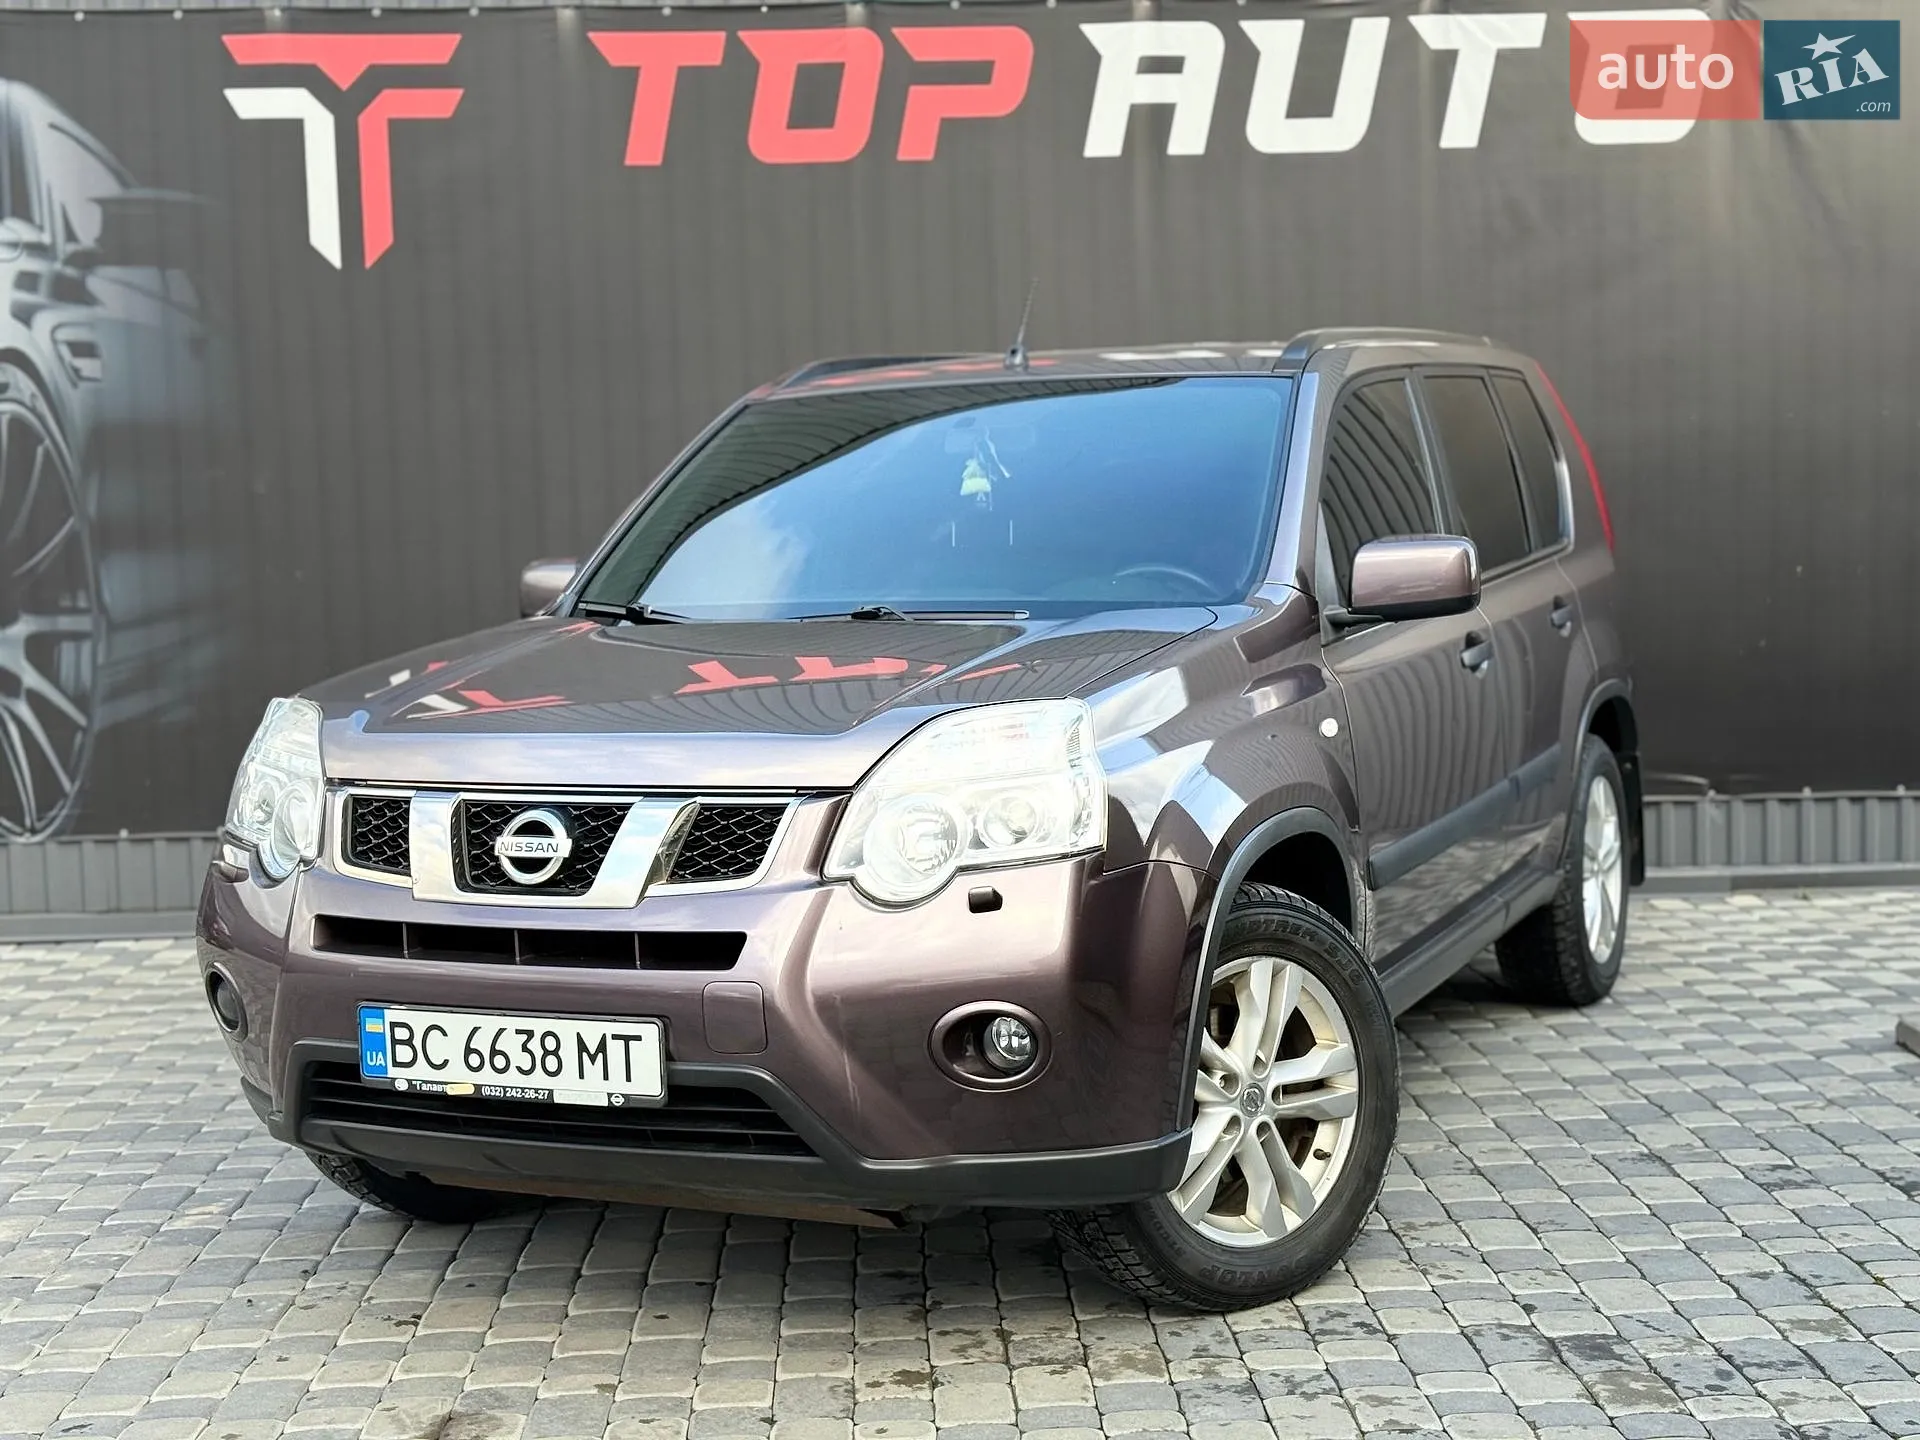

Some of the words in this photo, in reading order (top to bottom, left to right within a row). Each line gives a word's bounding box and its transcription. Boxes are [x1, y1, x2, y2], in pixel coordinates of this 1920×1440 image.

[587, 27, 1035, 166] TOP
[1080, 7, 1714, 158] AUTO
[500, 841, 559, 853] NISSAN
[366, 1050, 386, 1067] UA
[388, 1021, 450, 1070] BC
[463, 1026, 563, 1078] 6638
[576, 1032, 642, 1082] MT
[481, 1086, 504, 1098] (032)
[505, 1087, 550, 1101] 242-26-27
